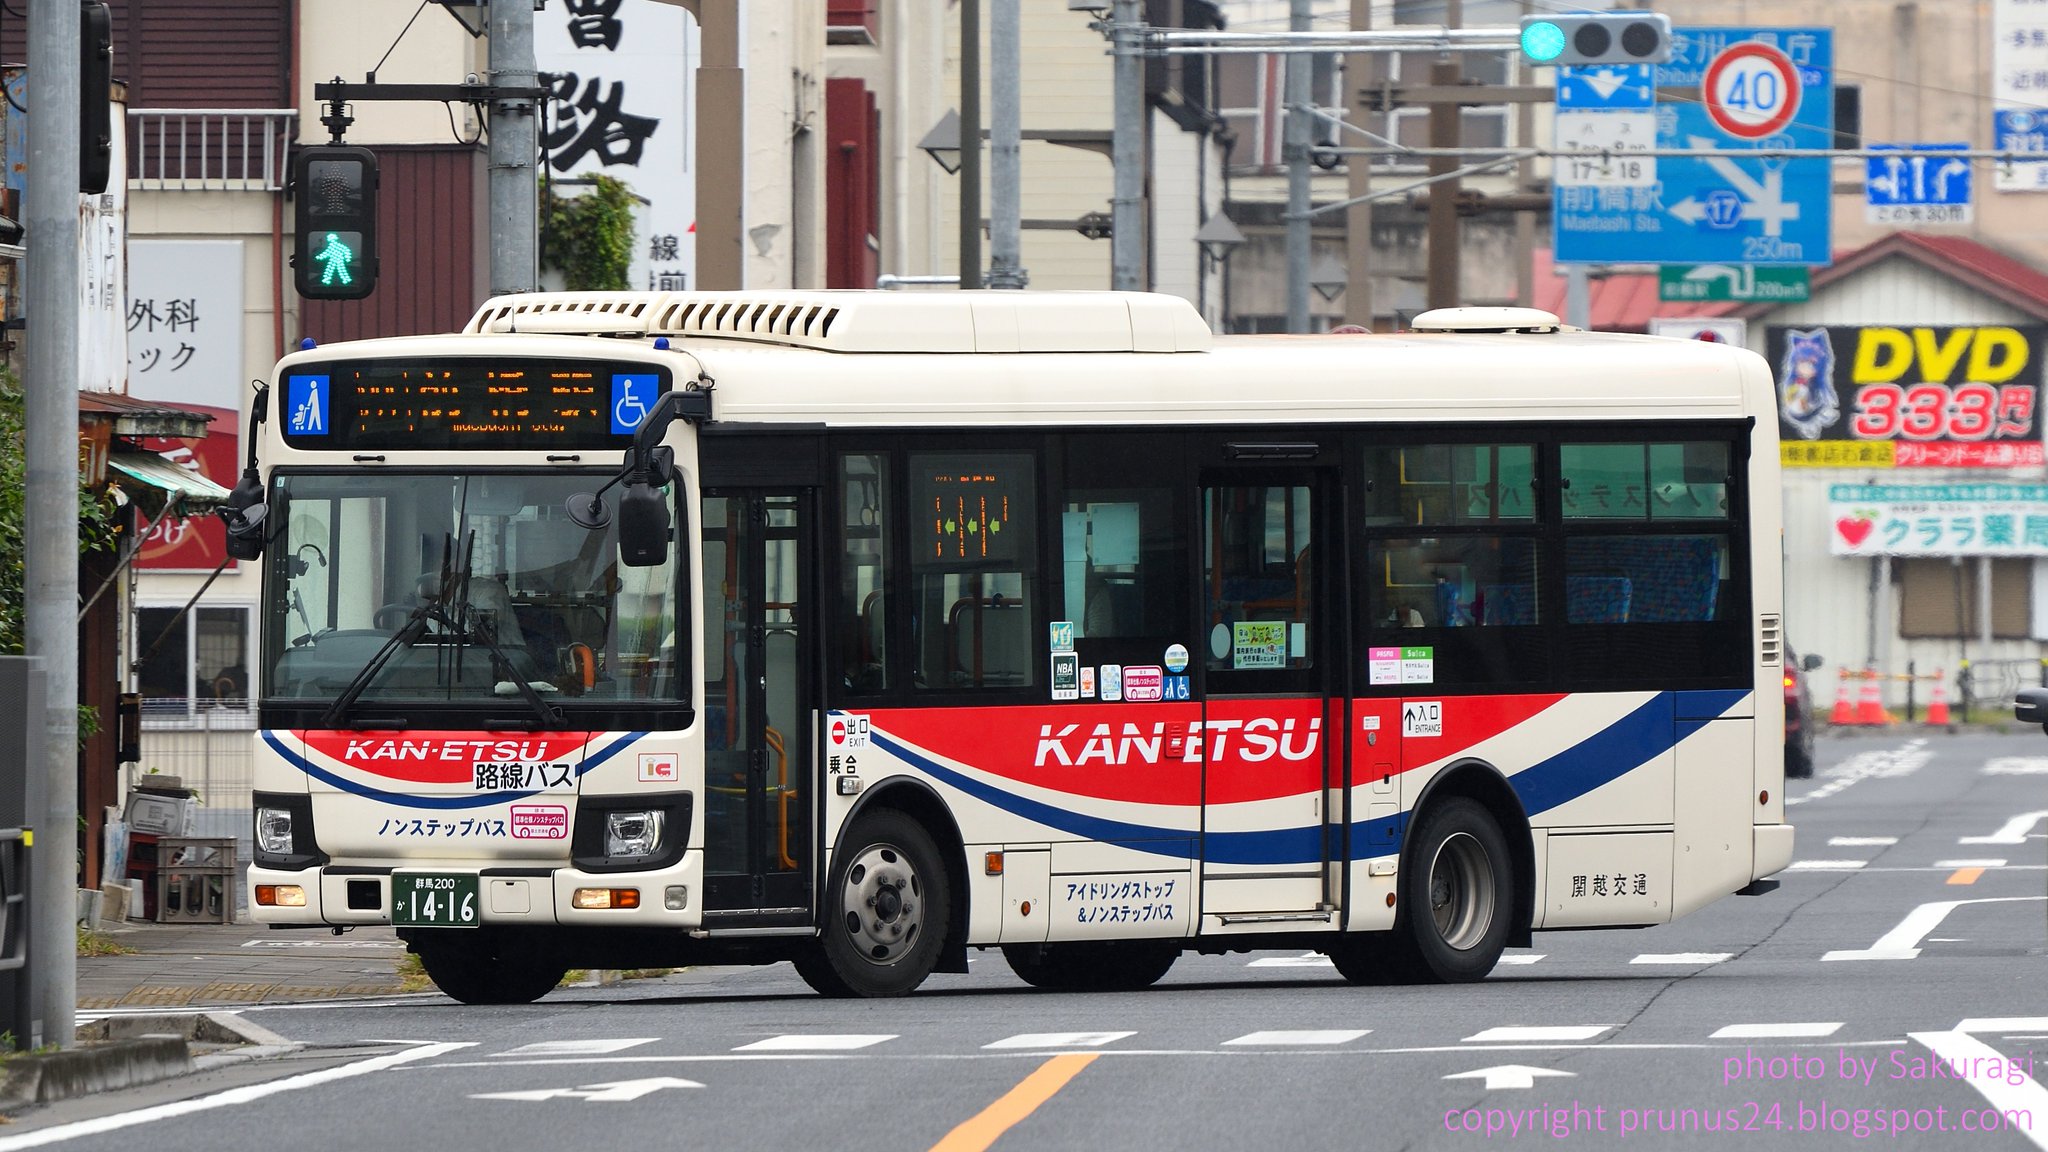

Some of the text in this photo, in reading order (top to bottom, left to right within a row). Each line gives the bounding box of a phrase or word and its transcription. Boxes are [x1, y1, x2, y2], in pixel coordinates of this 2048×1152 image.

[1727, 70, 1778, 111] 40
[1710, 198, 1736, 221] 17
[1563, 214, 1631, 231] Maebashi
[1742, 237, 1804, 260] 250m
[128, 341, 196, 373] ック
[1852, 328, 2030, 385] DVD
[1057, 663, 1073, 673] NBA
[1418, 706, 1438, 721] 入口
[847, 719, 868, 735] 出口
[1415, 724, 1441, 733] ENTRANCE
[849, 737, 865, 747] EXIT
[1034, 717, 1322, 767] KANETSU
[829, 755, 857, 774] 乗合
[475, 762, 573, 790] 路線バス
[378, 818, 507, 838] ノンステップバス
[415, 878, 455, 890] 群馬200
[1067, 880, 1175, 901] アイドリングストップ
[1571, 873, 1647, 897] 関越交通
[411, 891, 474, 922] 14-16
[1077, 903, 1174, 922] &ノンステップバス
